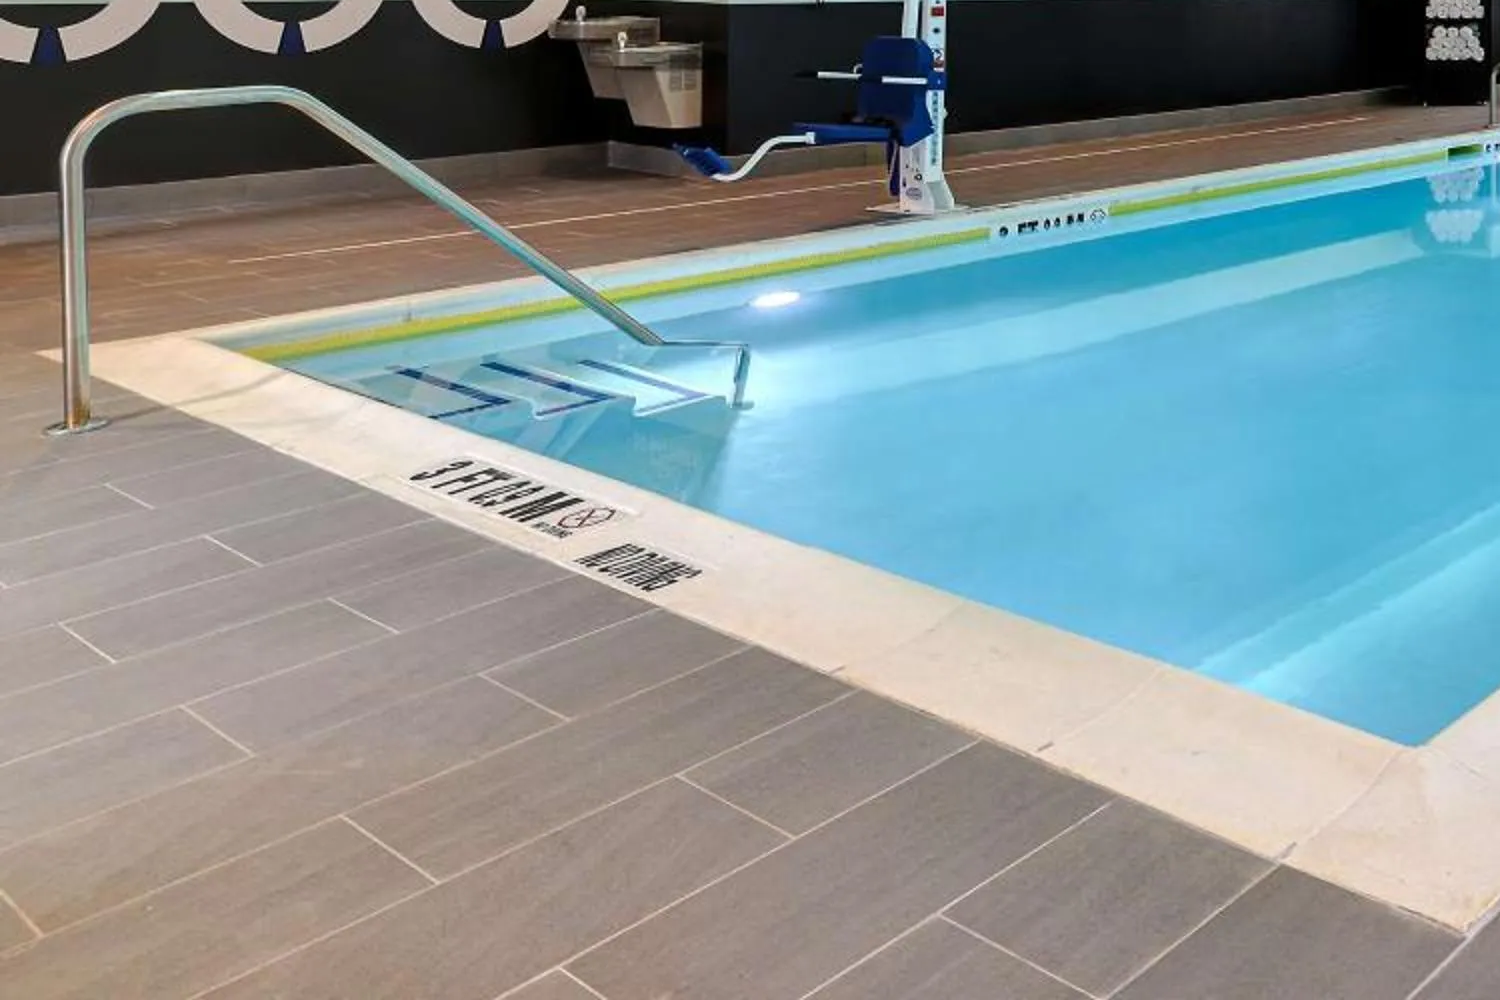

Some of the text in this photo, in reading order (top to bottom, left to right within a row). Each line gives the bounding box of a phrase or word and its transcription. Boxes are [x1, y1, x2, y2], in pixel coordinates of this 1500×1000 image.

[409, 460, 474, 481] 3
[430, 467, 513, 495] FT
[497, 490, 585, 523] M
